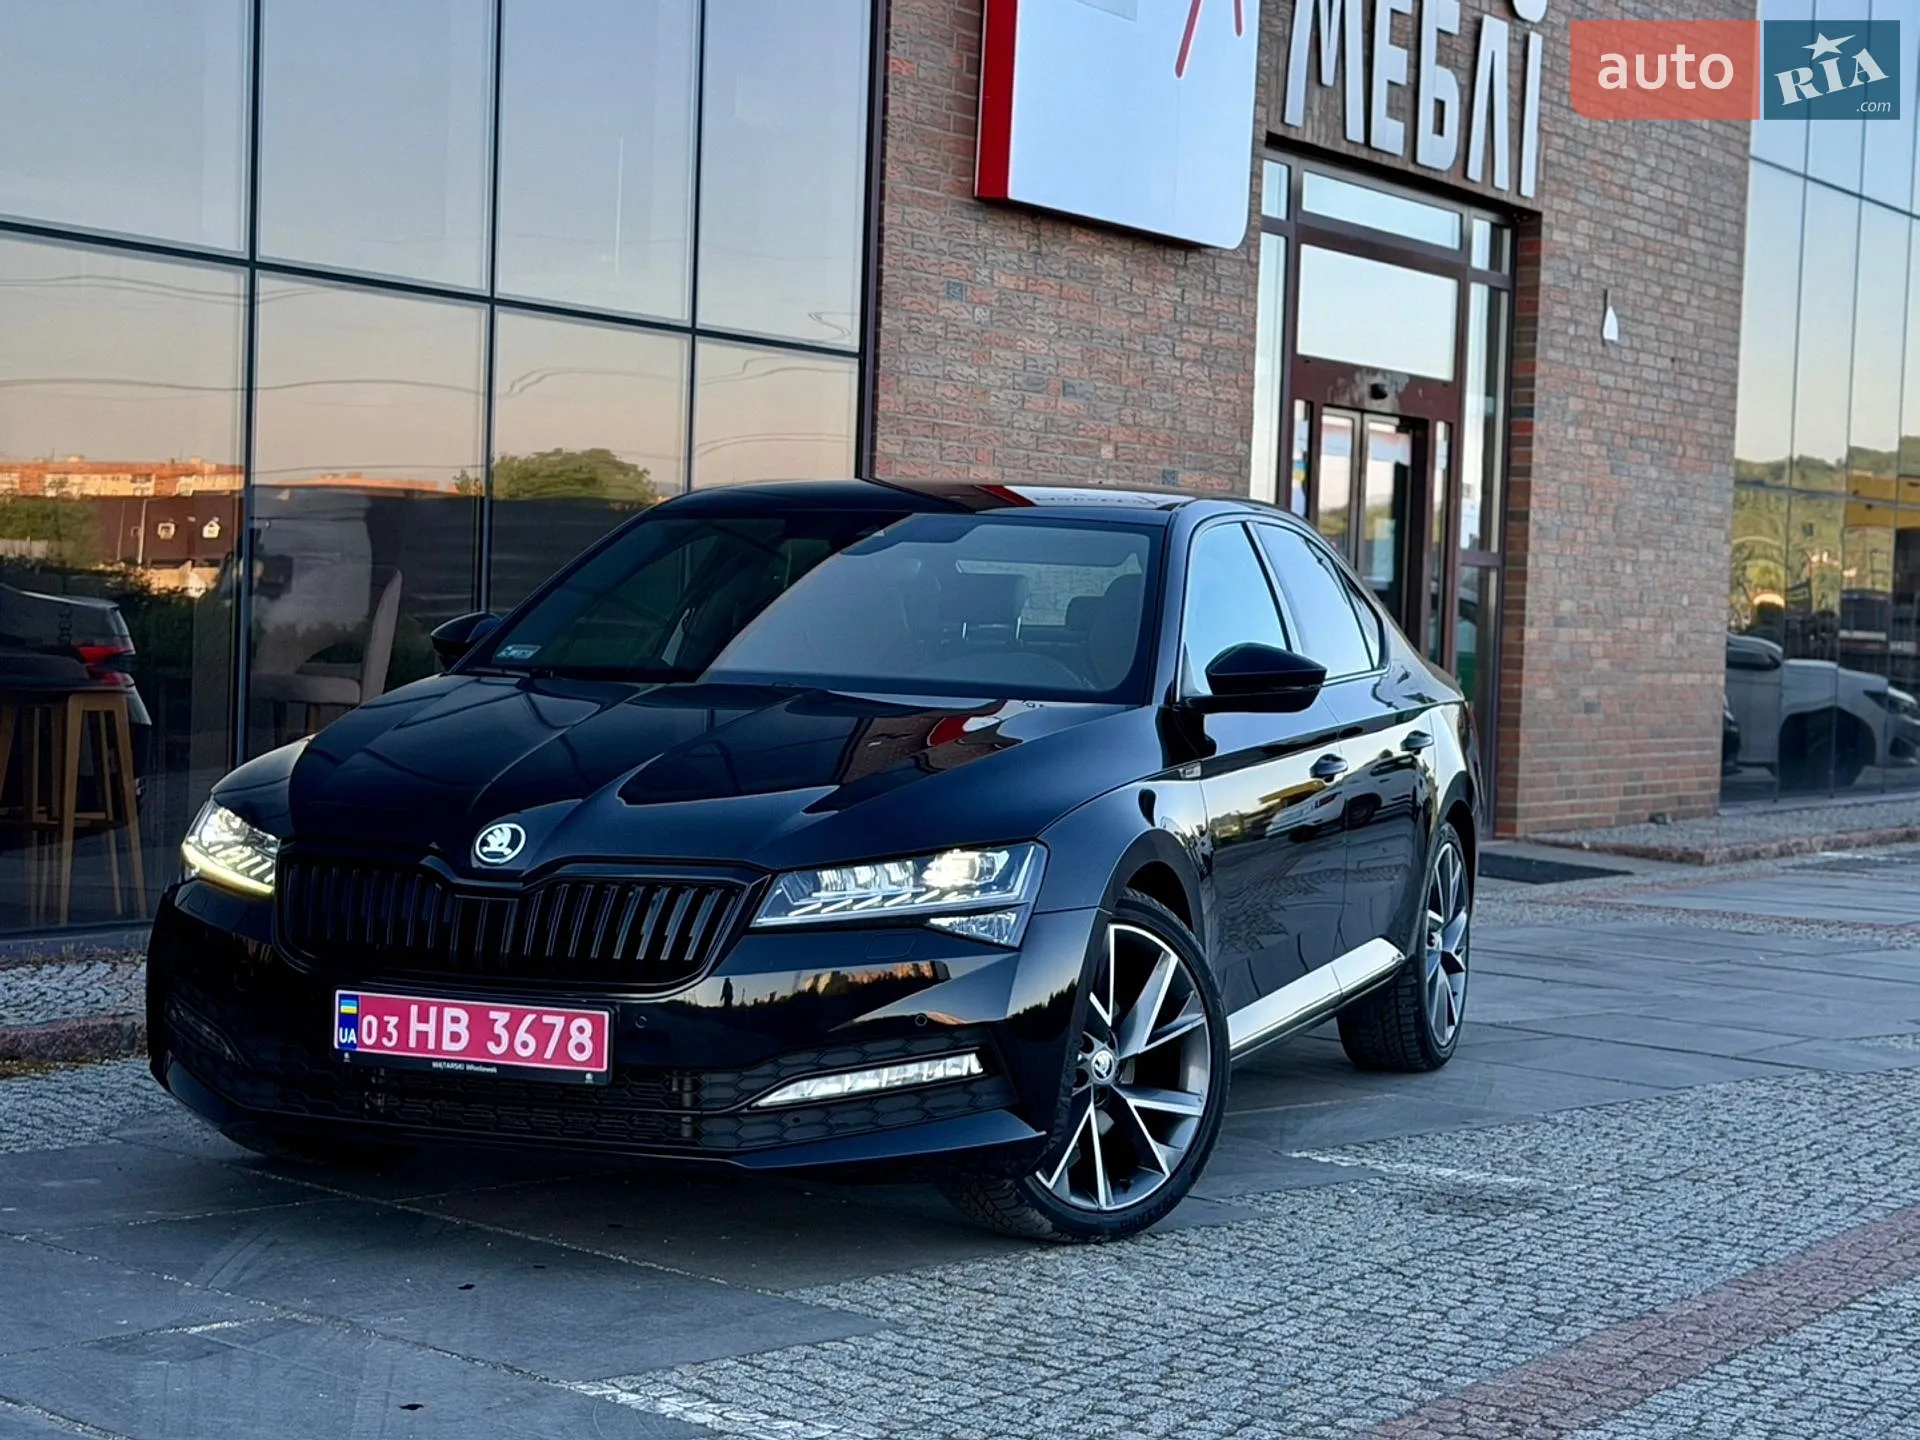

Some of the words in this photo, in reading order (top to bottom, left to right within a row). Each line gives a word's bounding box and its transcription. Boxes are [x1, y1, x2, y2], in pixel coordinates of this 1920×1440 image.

[339, 1027, 357, 1044] UA
[361, 1014, 399, 1048] 03
[408, 1004, 470, 1052] HB
[486, 1010, 594, 1062] 3678
